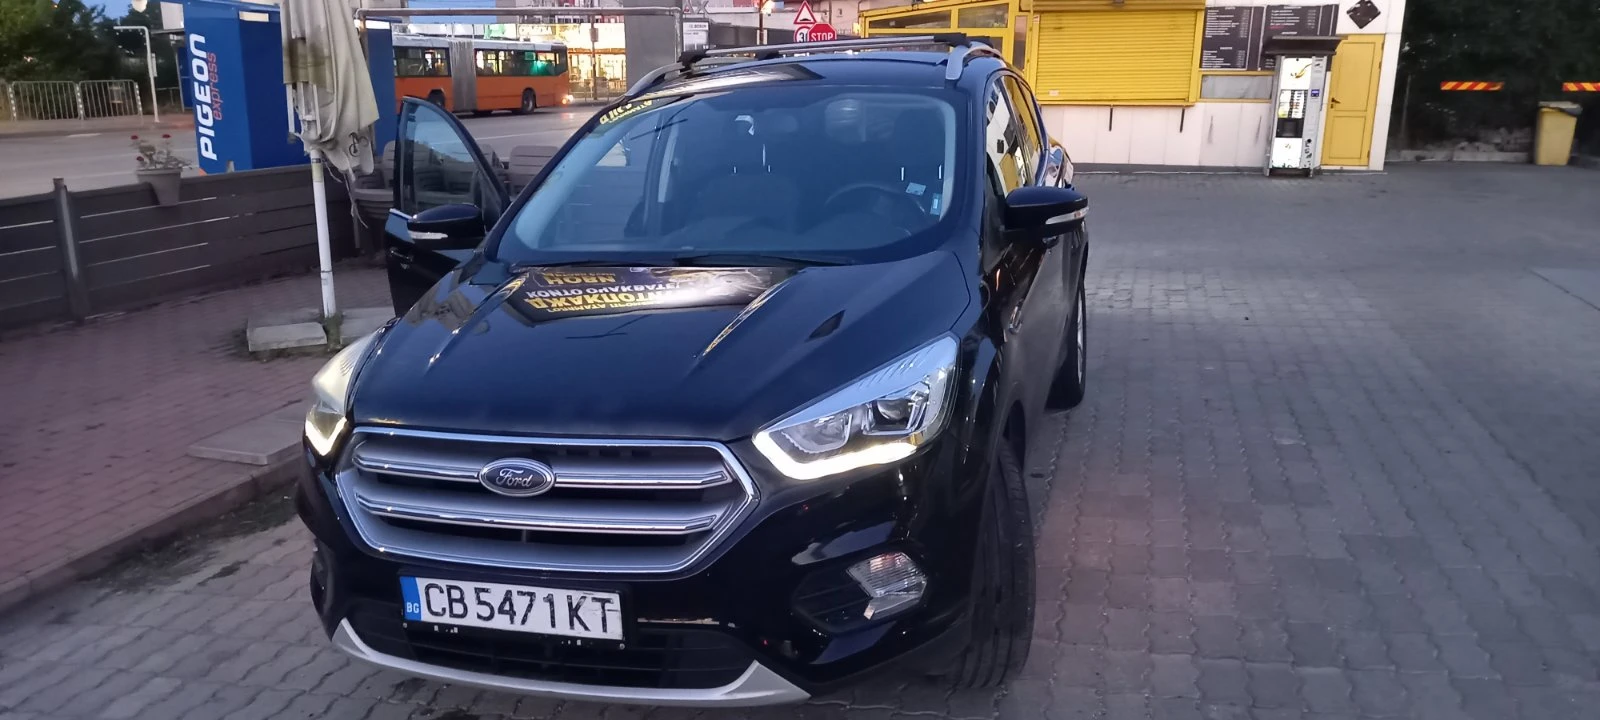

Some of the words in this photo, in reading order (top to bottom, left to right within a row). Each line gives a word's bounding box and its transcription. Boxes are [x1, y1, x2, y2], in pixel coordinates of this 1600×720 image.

[811, 32, 834, 41] STOP
[207, 52, 223, 120] express
[189, 33, 218, 160] PIGEON
[496, 468, 534, 487] Ford
[406, 602, 420, 614] BG
